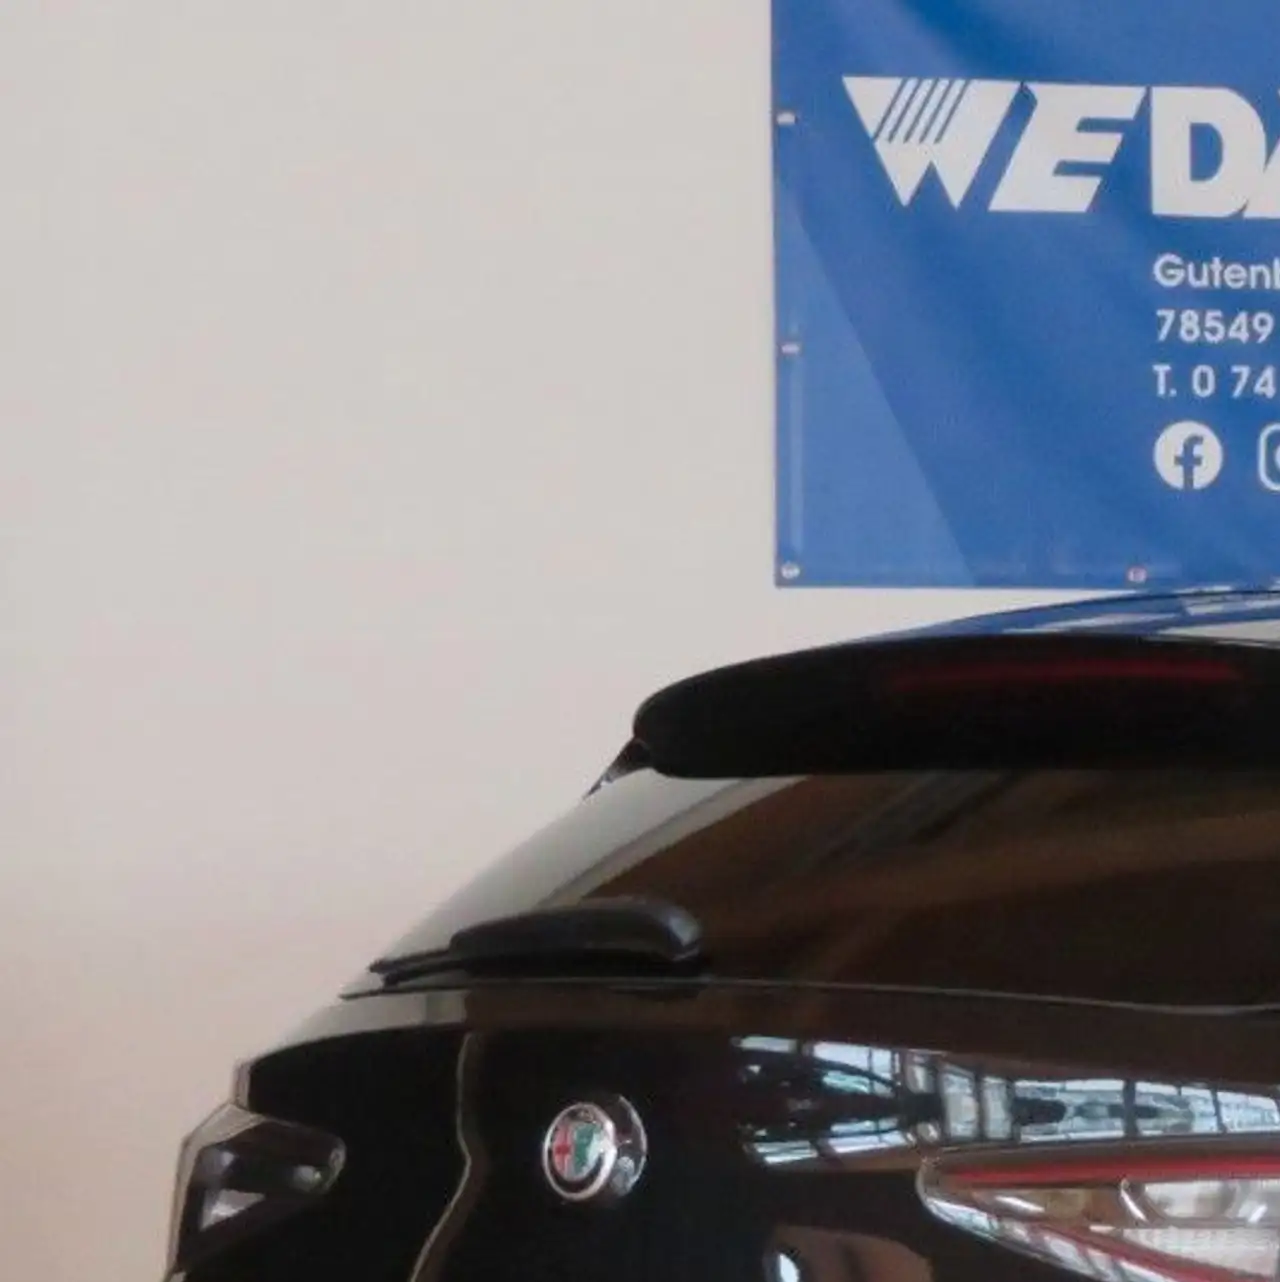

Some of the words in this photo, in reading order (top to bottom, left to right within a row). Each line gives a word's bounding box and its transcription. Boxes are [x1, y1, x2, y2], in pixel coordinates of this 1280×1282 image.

[1156, 309, 1275, 345] 78549
[1152, 364, 1177, 397] T.
[1192, 365, 1215, 398] 0
[1231, 366, 1275, 398] 74
